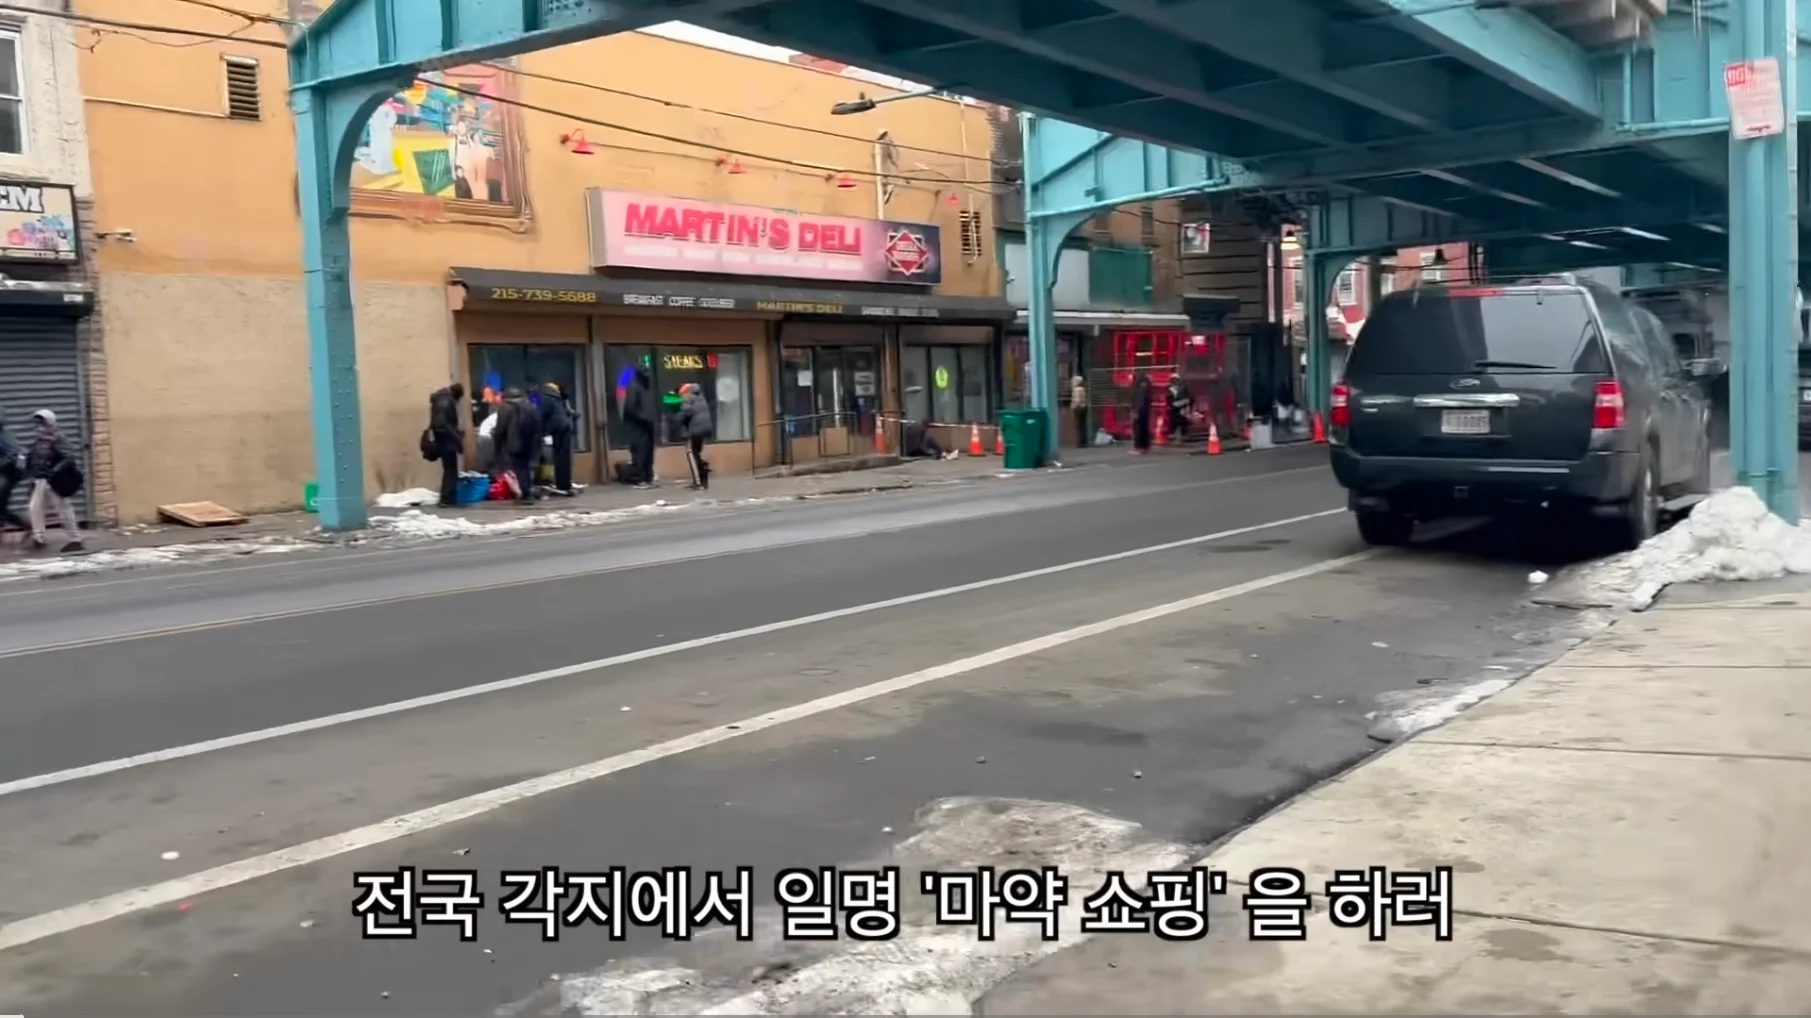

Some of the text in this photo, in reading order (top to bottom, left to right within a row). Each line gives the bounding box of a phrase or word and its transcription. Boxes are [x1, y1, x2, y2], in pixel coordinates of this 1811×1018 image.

[624, 203, 789, 250] MARTIN'S
[798, 222, 862, 256] DELI
[491, 287, 597, 303] 215-739-5688
